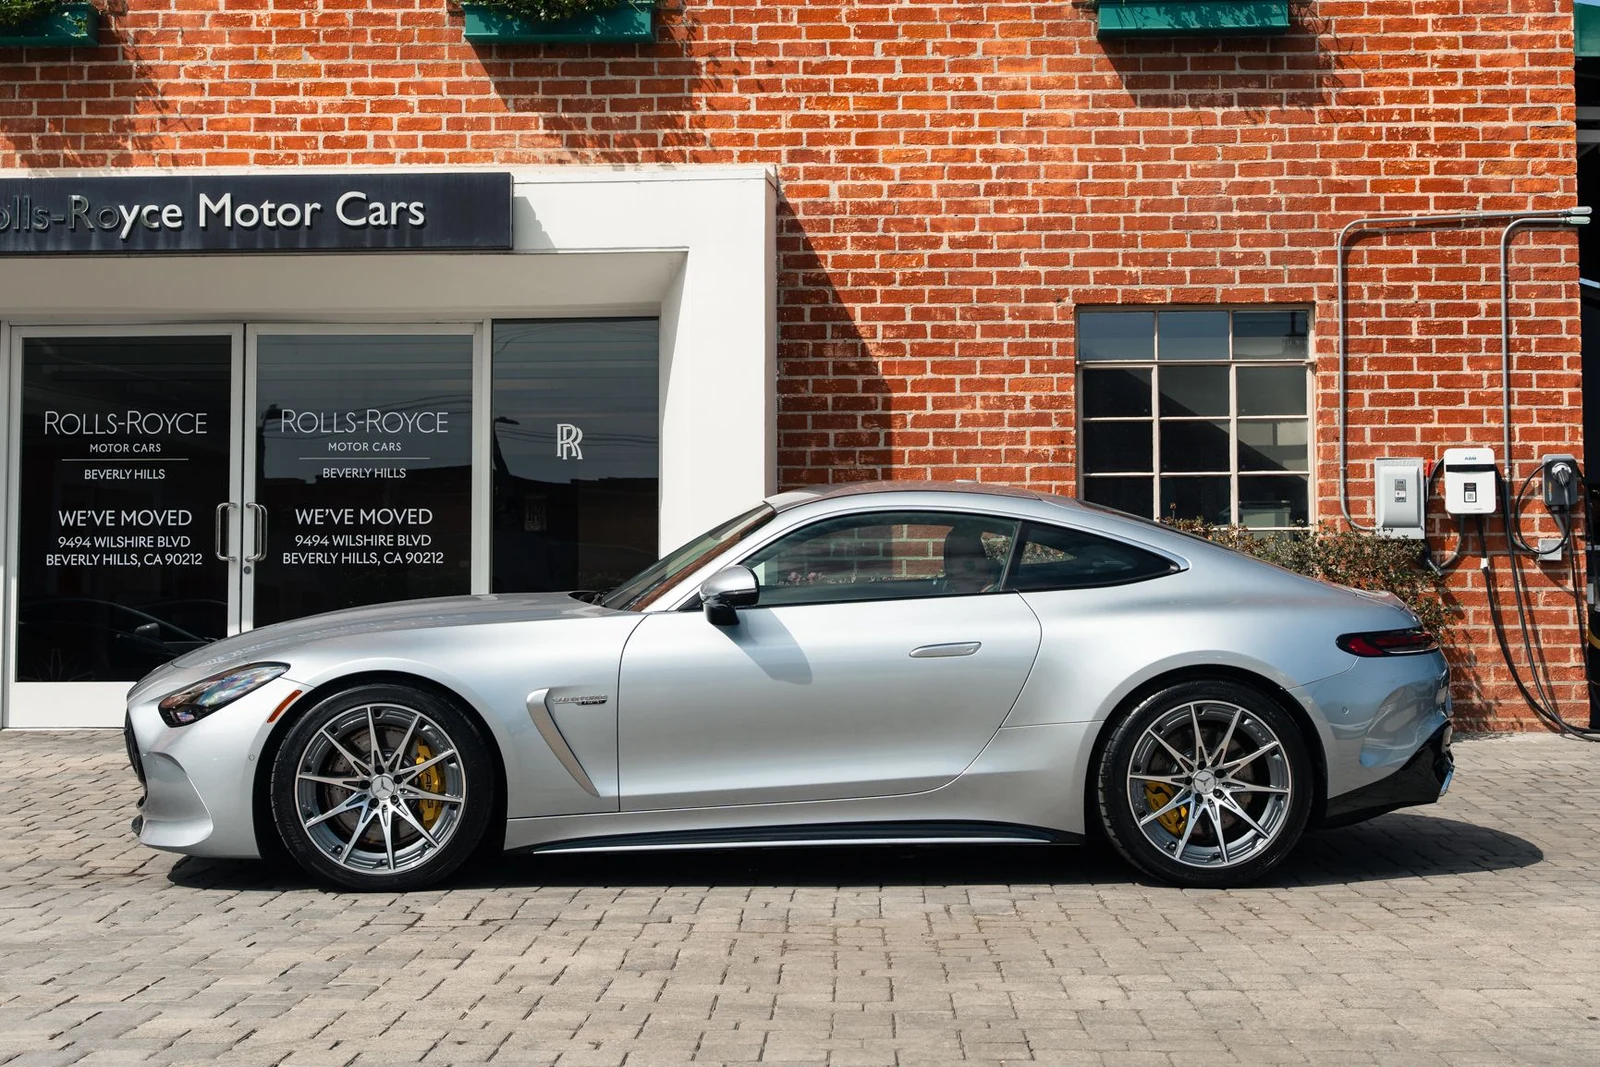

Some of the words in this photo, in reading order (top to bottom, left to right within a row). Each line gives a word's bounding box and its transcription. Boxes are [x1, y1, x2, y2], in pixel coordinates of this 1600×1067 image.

[199, 192, 321, 228] Motor
[335, 190, 425, 227] Cars
[44, 410, 208, 435] ROLLS-ROYCE
[281, 409, 449, 434] ROLLS-ROYCE
[89, 443, 130, 453] MOTOR
[132, 443, 162, 453] CARS
[328, 442, 369, 452] MOTOR
[372, 442, 402, 452] CARS
[556, 423, 584, 460] RR
[84, 469, 132, 480] BEVERLY
[134, 468, 166, 480] HILLS
[322, 467, 372, 479] BEVERLY
[374, 467, 407, 479] HILLS
[121, 509, 193, 527] MOVED
[359, 508, 433, 525] MOVED
[57, 536, 92, 548] 9494
[93, 536, 154, 548] WILSHIRE
[157, 535, 191, 548] BLVD
[294, 534, 330, 547] 9494
[331, 534, 394, 547] WILSHIRE
[397, 534, 432, 547] BLVD
[46, 553, 100, 566] BEVERLY
[102, 553, 141, 568] HILLS,
[143, 553, 163, 566] CA
[164, 553, 203, 566] 90212
[282, 552, 339, 565] BEVERLY
[341, 551, 381, 567] HILLS,
[383, 551, 404, 564] CA
[405, 551, 444, 564] 90212
